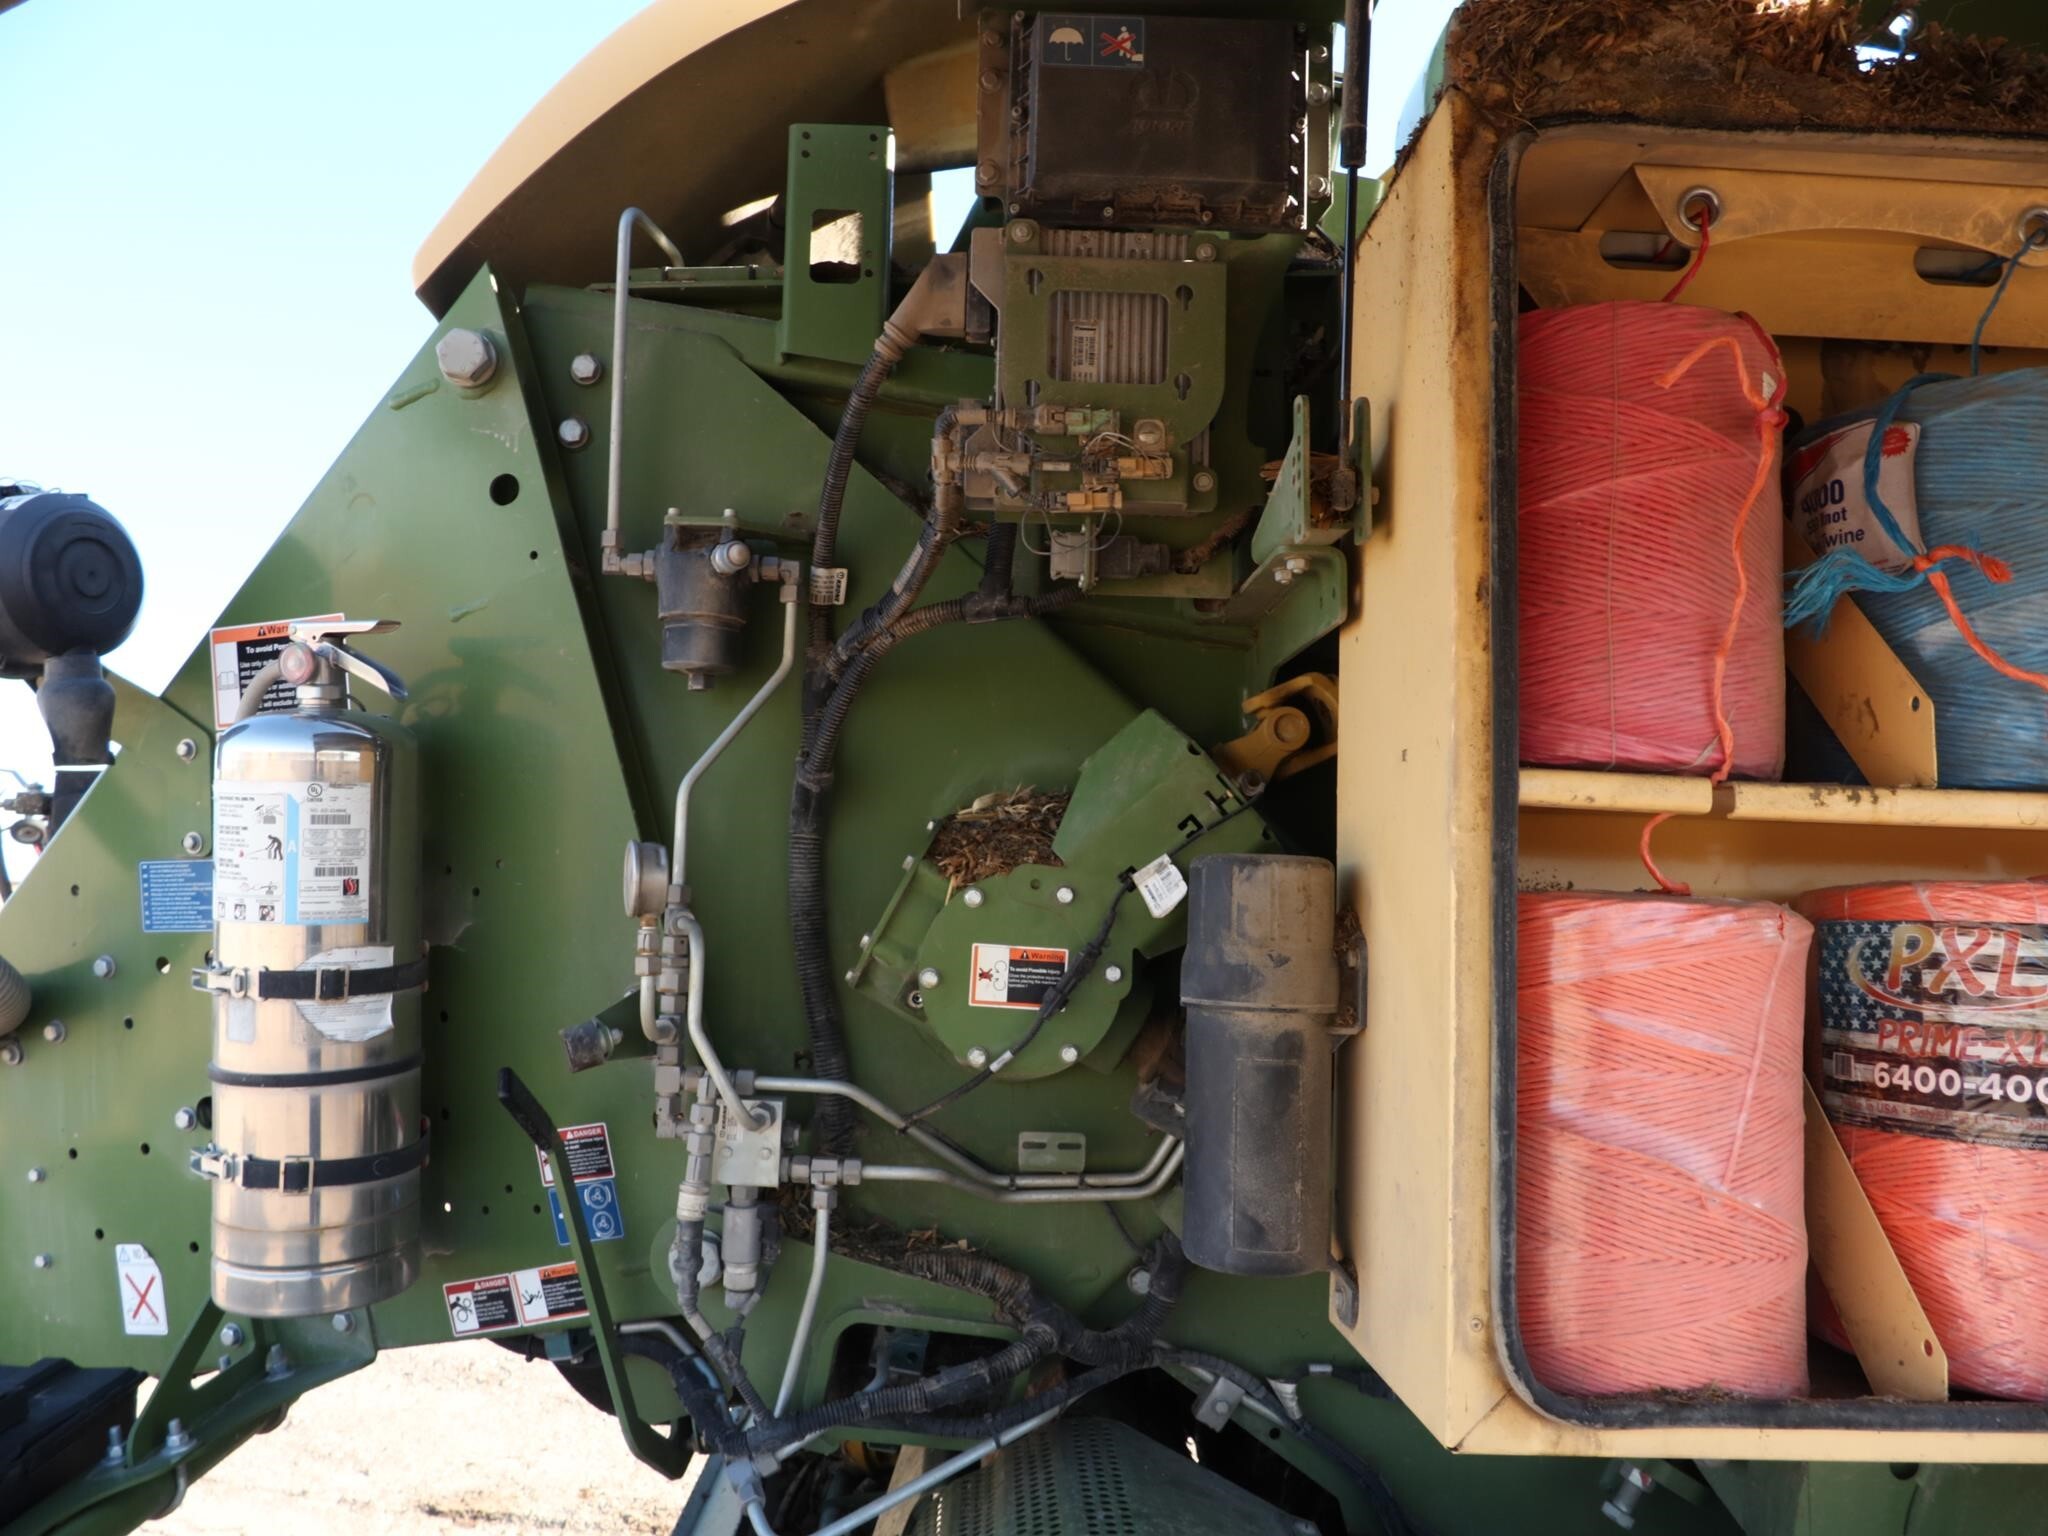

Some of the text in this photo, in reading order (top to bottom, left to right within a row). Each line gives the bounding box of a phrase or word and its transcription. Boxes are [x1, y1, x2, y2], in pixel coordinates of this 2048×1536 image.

[256, 645, 273, 653] avoid
[1031, 951, 1064, 962] Warning
[1886, 923, 2048, 998] PXL
[1877, 1103, 1898, 1115] USA
[573, 1127, 601, 1137] DANGER
[480, 1278, 507, 1289] DANGER
